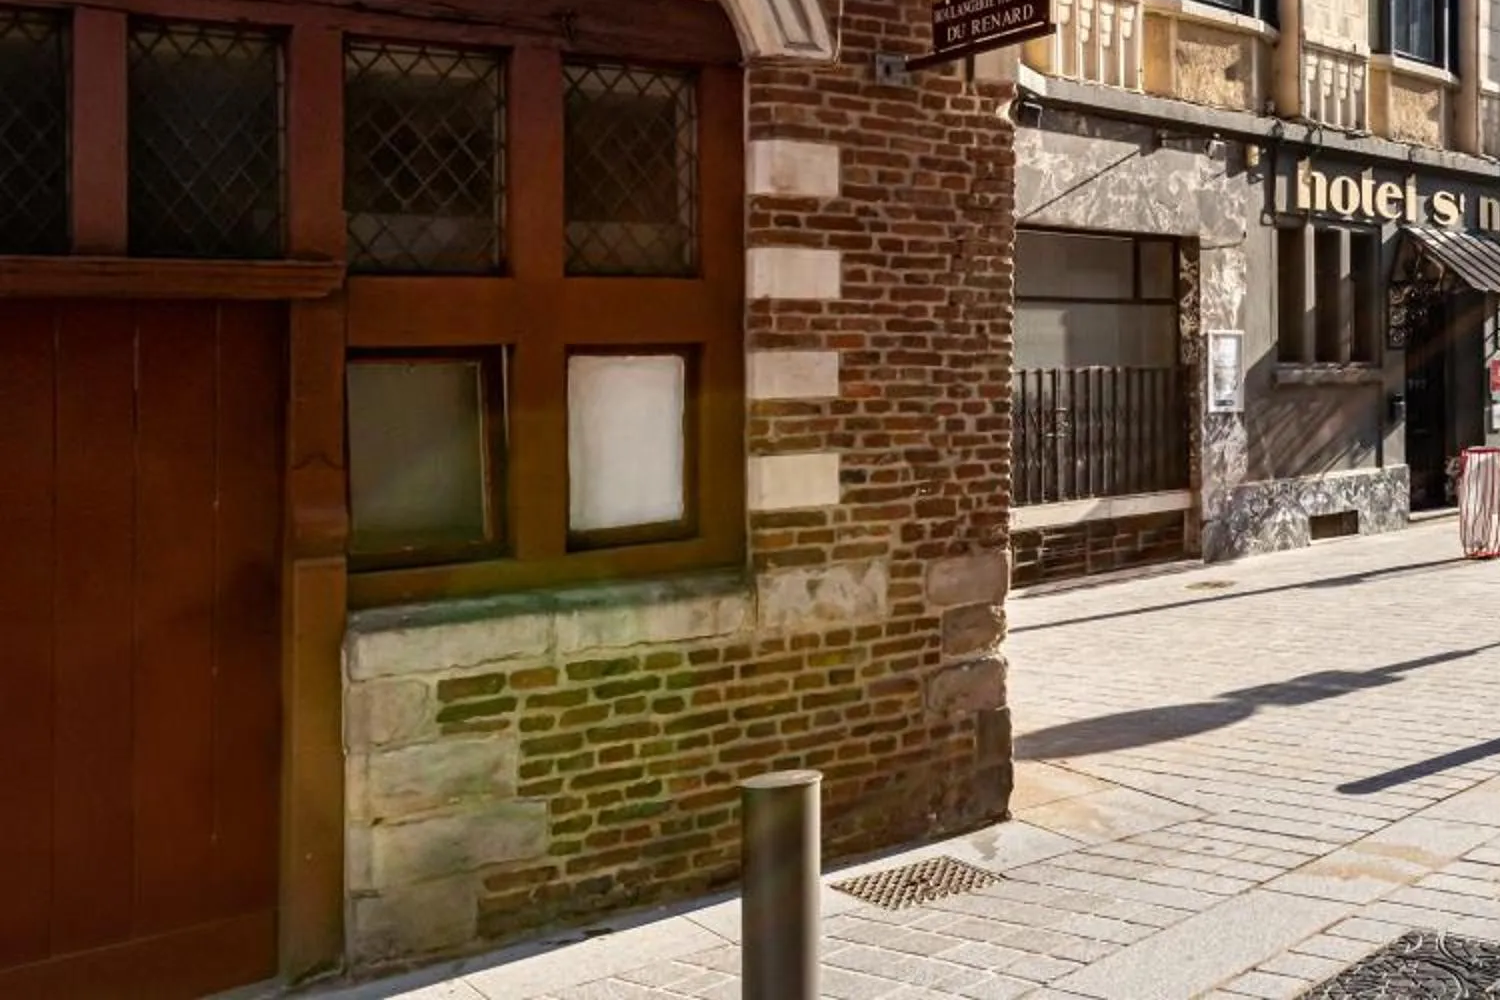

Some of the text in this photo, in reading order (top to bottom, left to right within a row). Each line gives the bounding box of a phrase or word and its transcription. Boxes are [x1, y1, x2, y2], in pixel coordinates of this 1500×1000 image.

[947, 3, 1035, 43] DU RENARD
[1297, 157, 1417, 223] hotel
